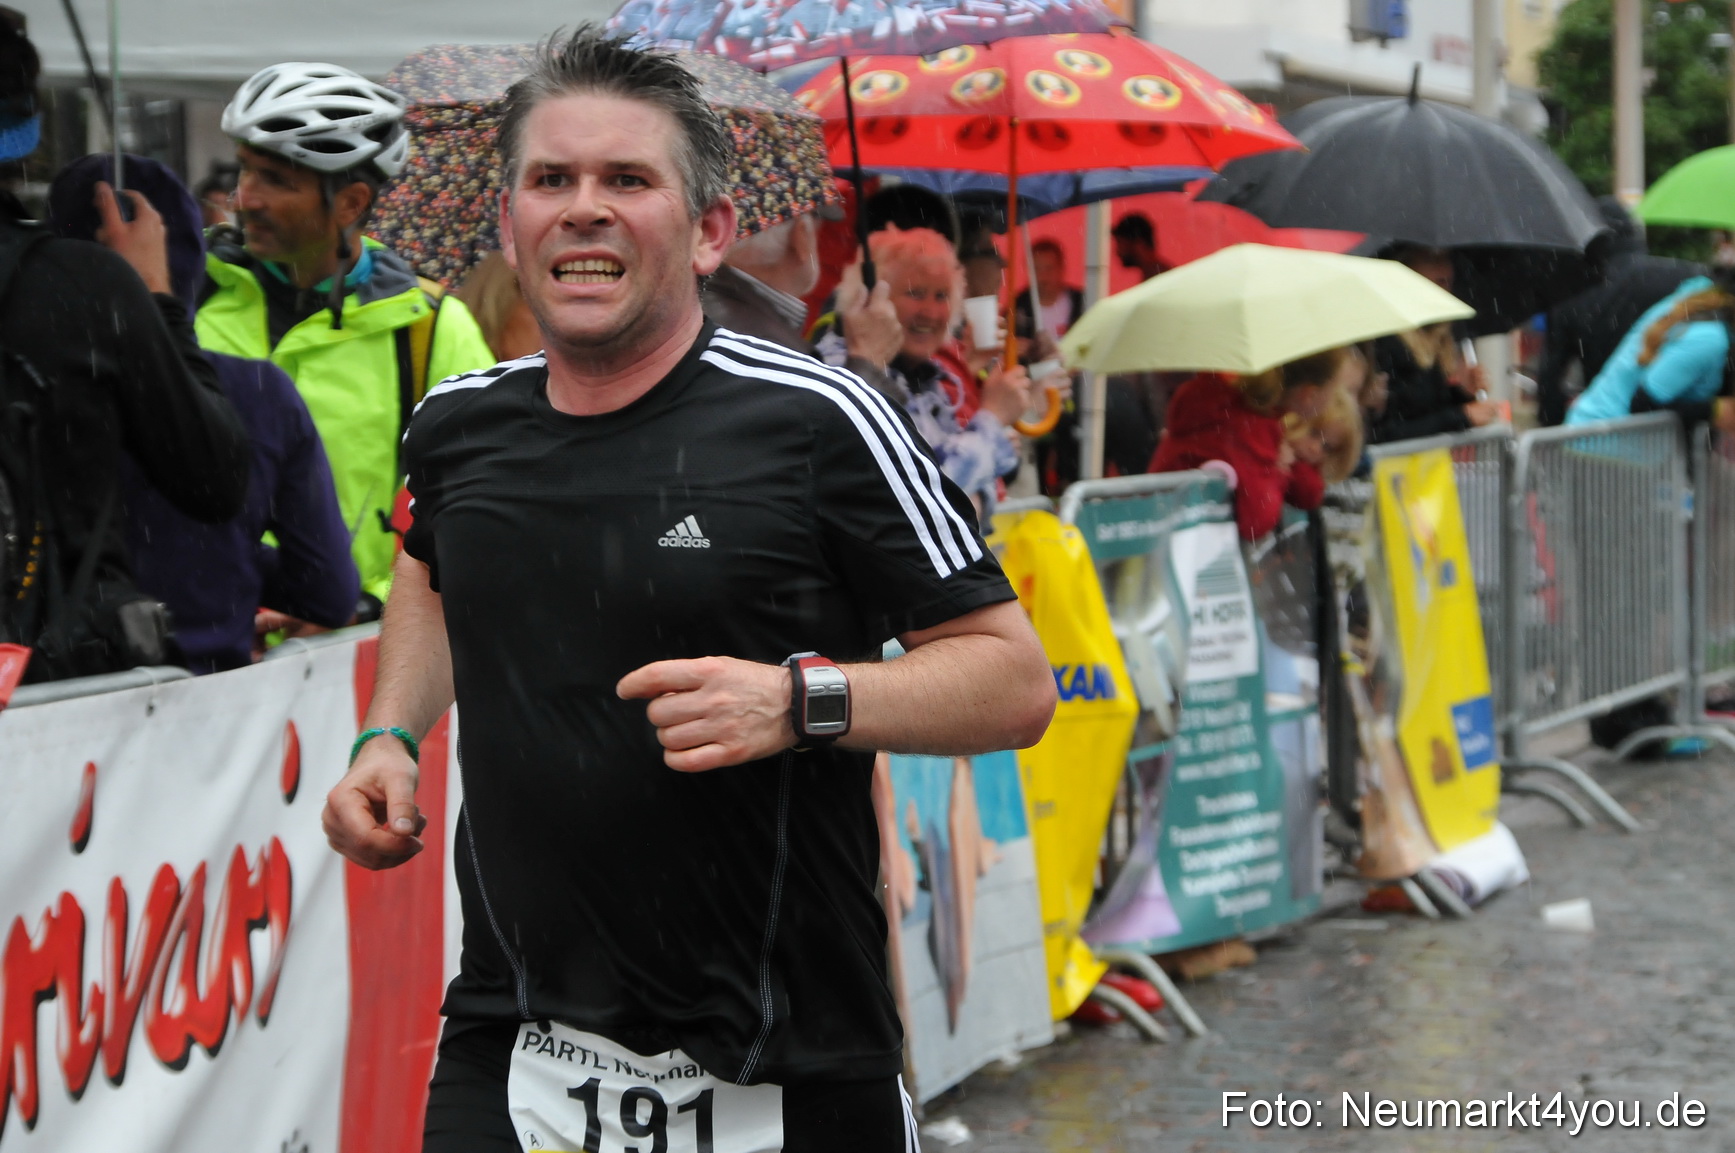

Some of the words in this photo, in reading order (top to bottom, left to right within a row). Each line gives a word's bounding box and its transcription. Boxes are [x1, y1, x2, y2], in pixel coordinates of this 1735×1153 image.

[658, 534, 711, 549] adidas
[521, 1031, 608, 1070] PARTL
[567, 1077, 715, 1153] 191
